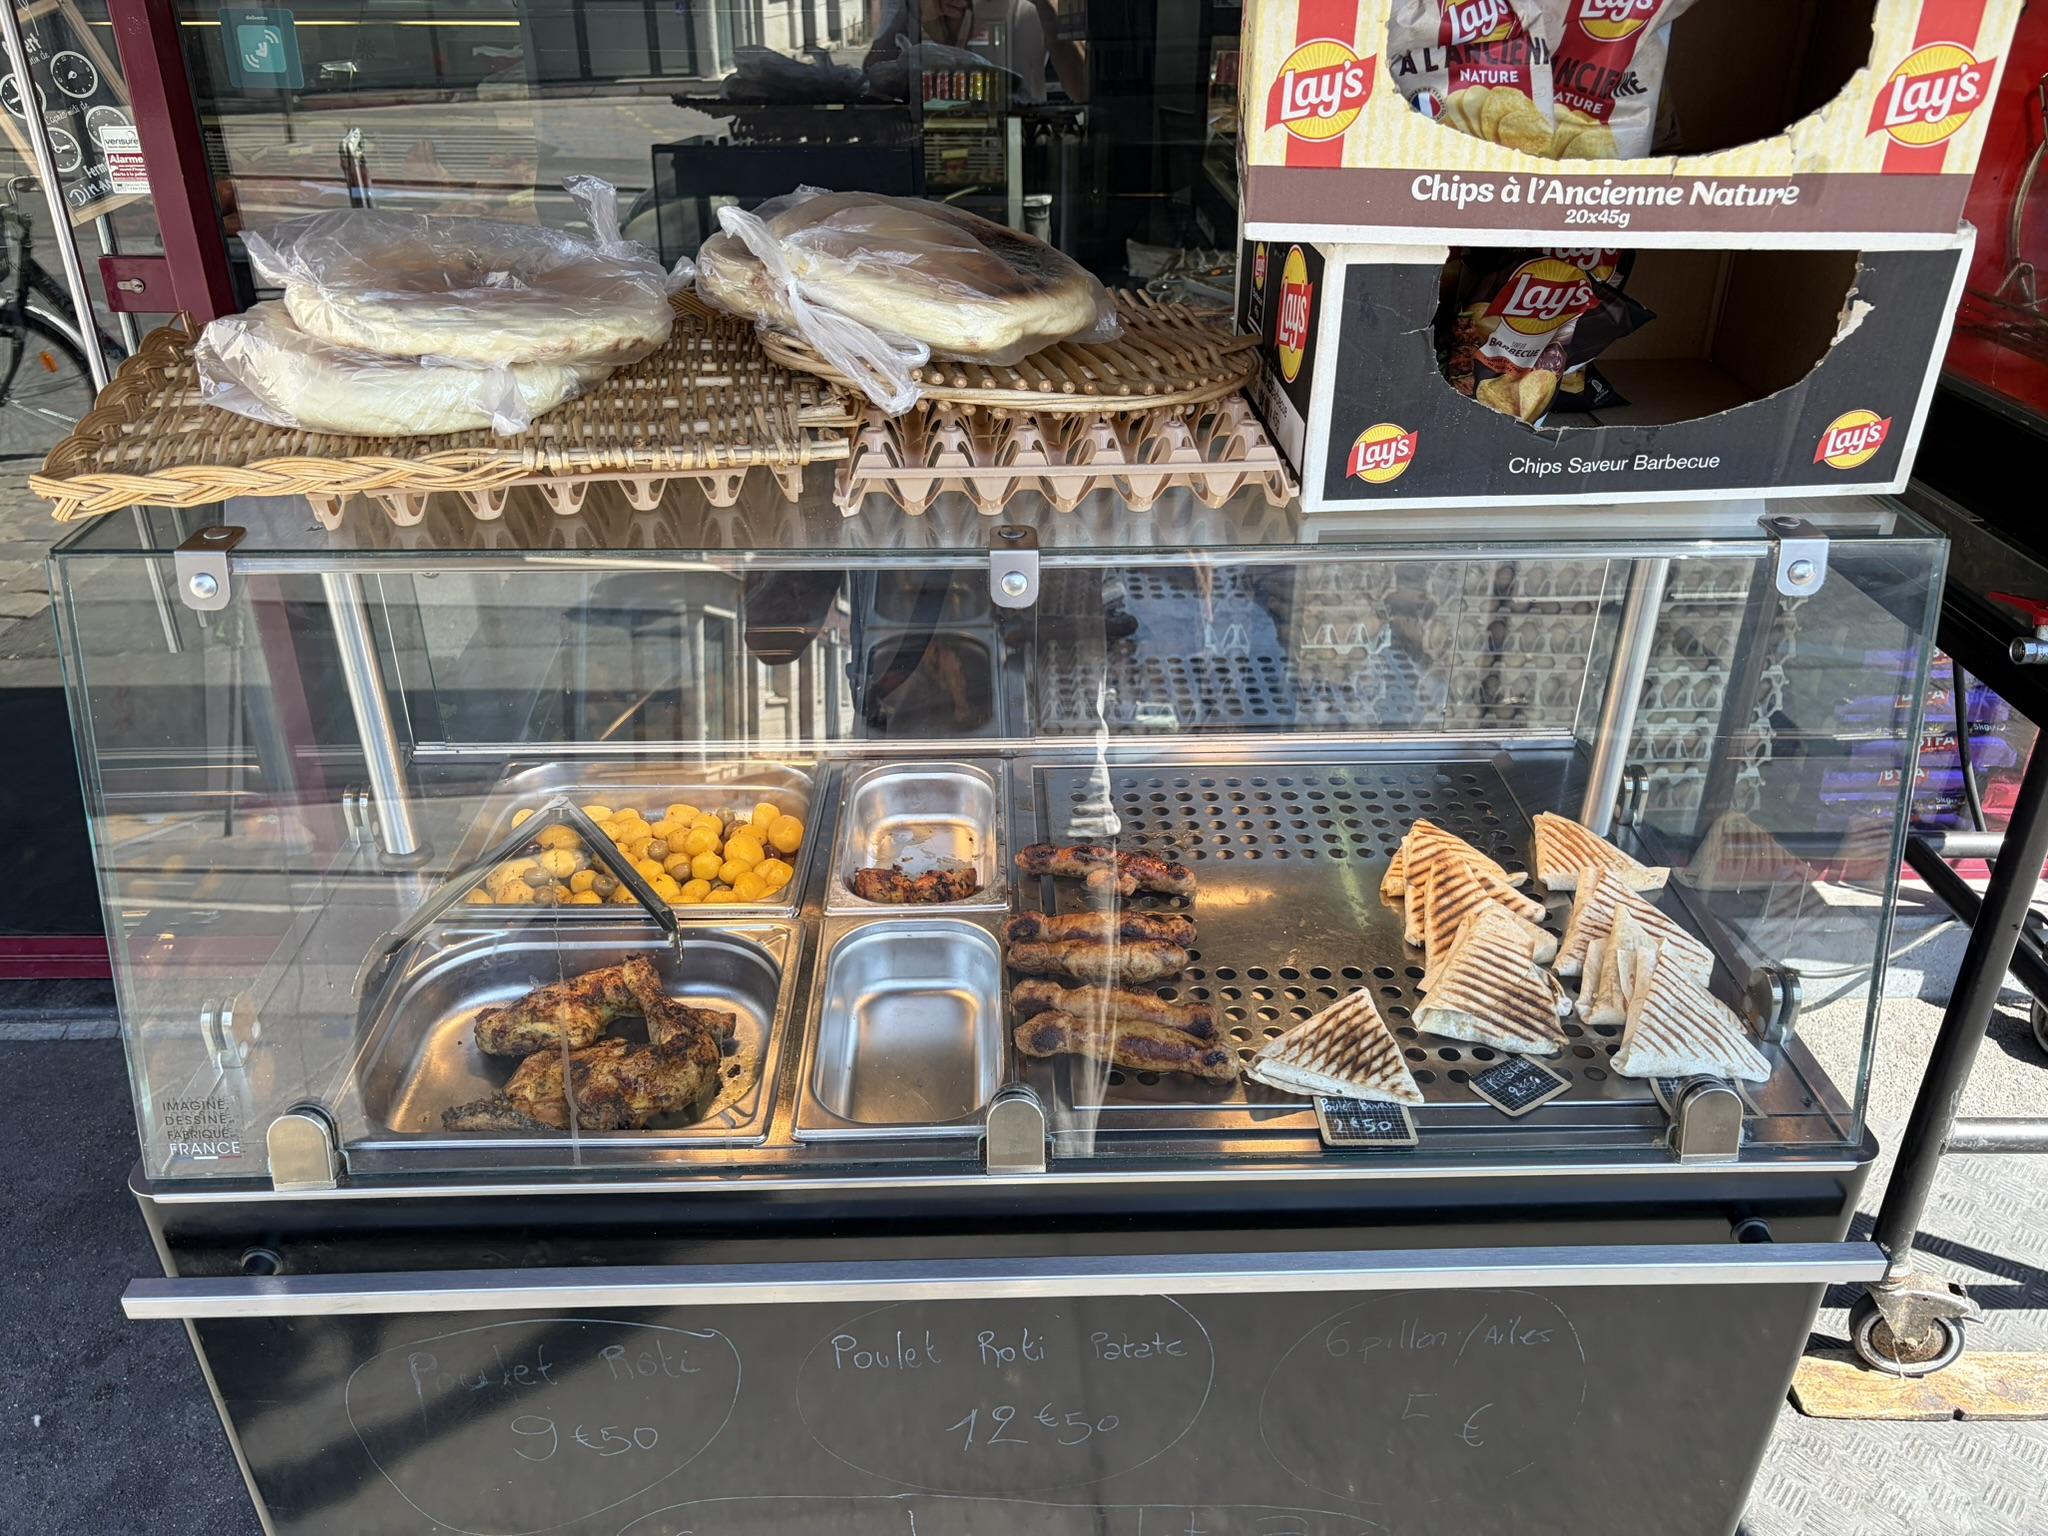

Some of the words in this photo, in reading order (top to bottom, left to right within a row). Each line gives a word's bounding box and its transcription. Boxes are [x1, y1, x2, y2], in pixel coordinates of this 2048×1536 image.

[1449, 0, 1509, 45] Lays
[1280, 60, 1364, 121] Lay's
[1459, 68, 1519, 84] NATURE
[1883, 63, 1981, 126] Lay's
[1553, 92, 1603, 114] ATURE
[110, 154, 144, 164] Alarme
[1411, 175, 1494, 209] Chips
[1500, 178, 1521, 203] à
[1527, 179, 1684, 206] l'Ancienne
[1690, 181, 1800, 206] Nature
[1564, 208, 1630, 228] 20x45g
[1279, 278, 1306, 351] Lay's
[1502, 274, 1594, 320] Lay's
[1356, 435, 1410, 472] Lay's
[1825, 421, 1881, 458] Lay's
[1508, 457, 1562, 478] Chips
[1568, 457, 1628, 474] Saveur
[1634, 454, 1720, 471] Barbecue
[170, 1141, 240, 1156] FRANCE
[831, 1330, 942, 1370] Poulet
[976, 1328, 1045, 1369] Roti
[1091, 1330, 1188, 1360] Patate
